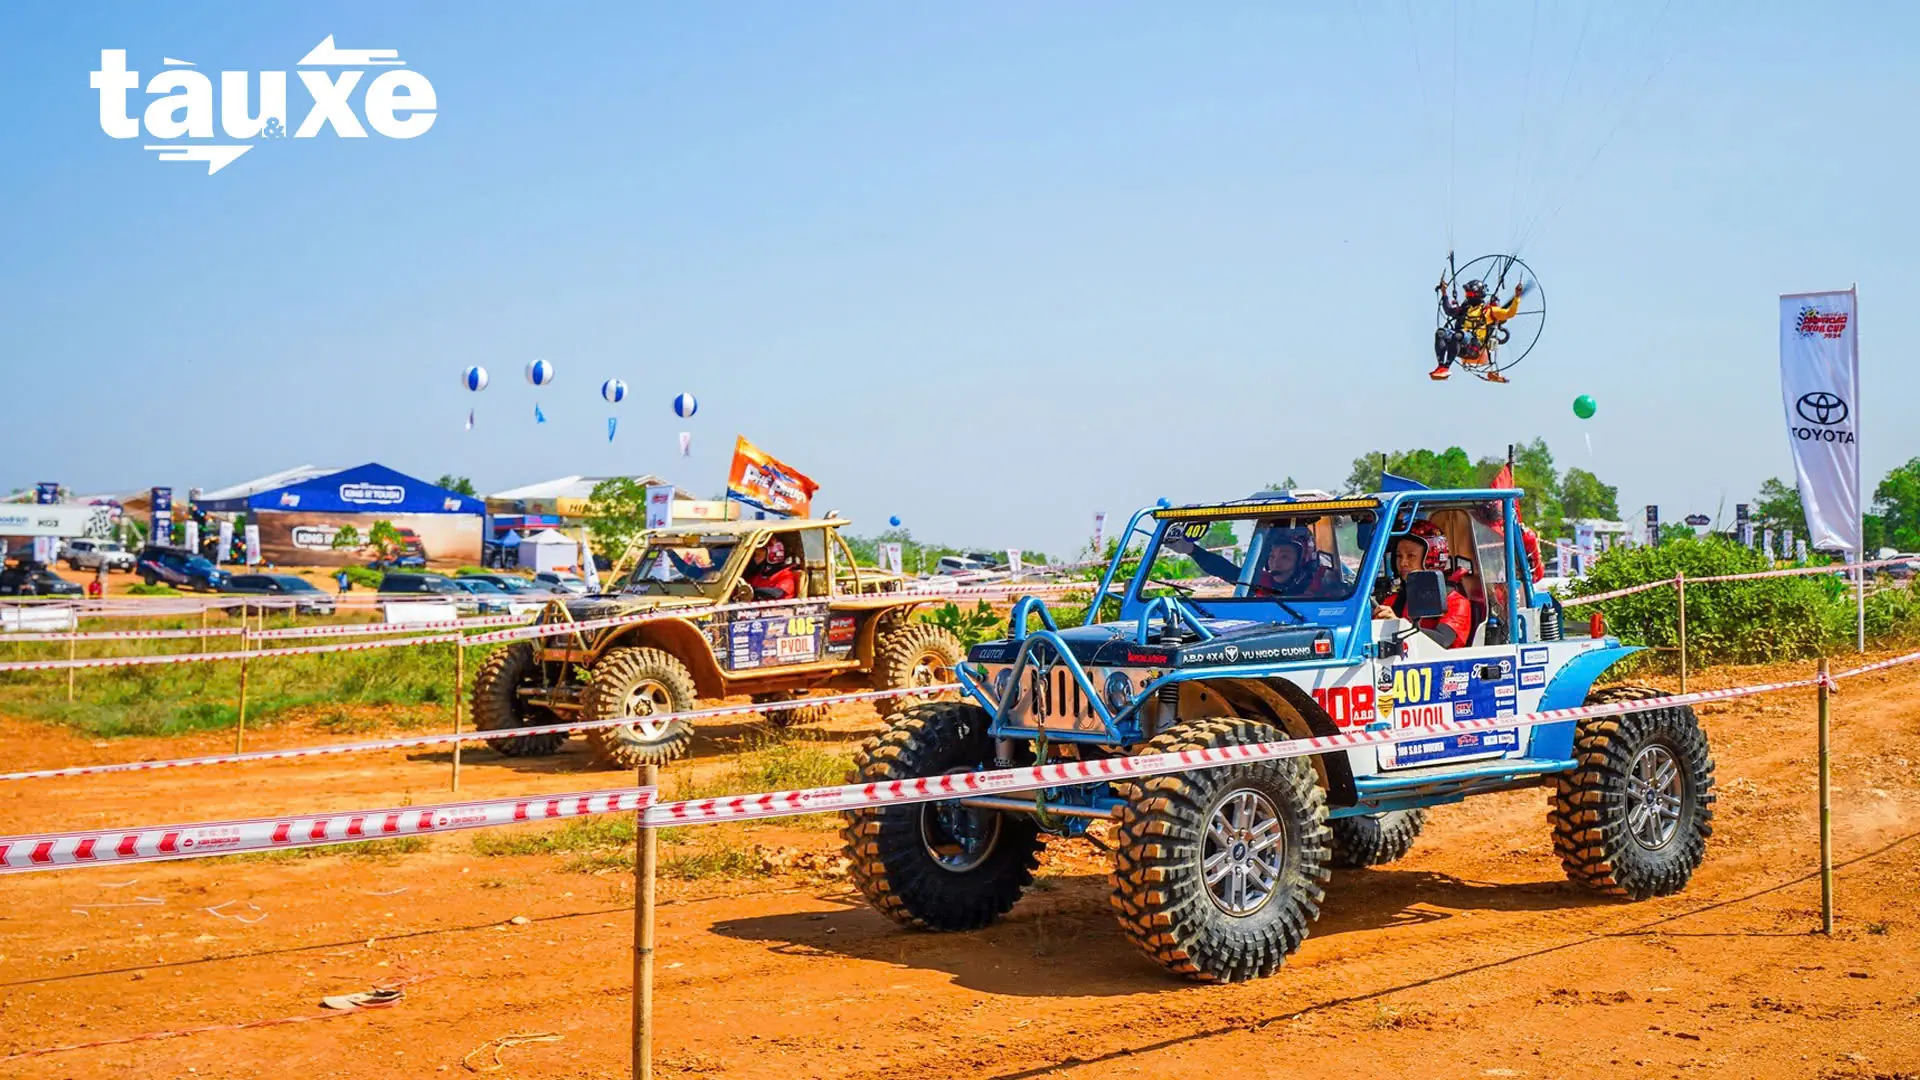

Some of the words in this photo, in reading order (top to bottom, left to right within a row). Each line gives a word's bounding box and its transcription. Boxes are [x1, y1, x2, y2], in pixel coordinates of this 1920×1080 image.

[1792, 427, 1854, 444] TOYOTA
[1184, 524, 1208, 538] 407
[788, 616, 815, 636] 406
[781, 638, 811, 653] PVOIL
[1392, 667, 1432, 704] 407
